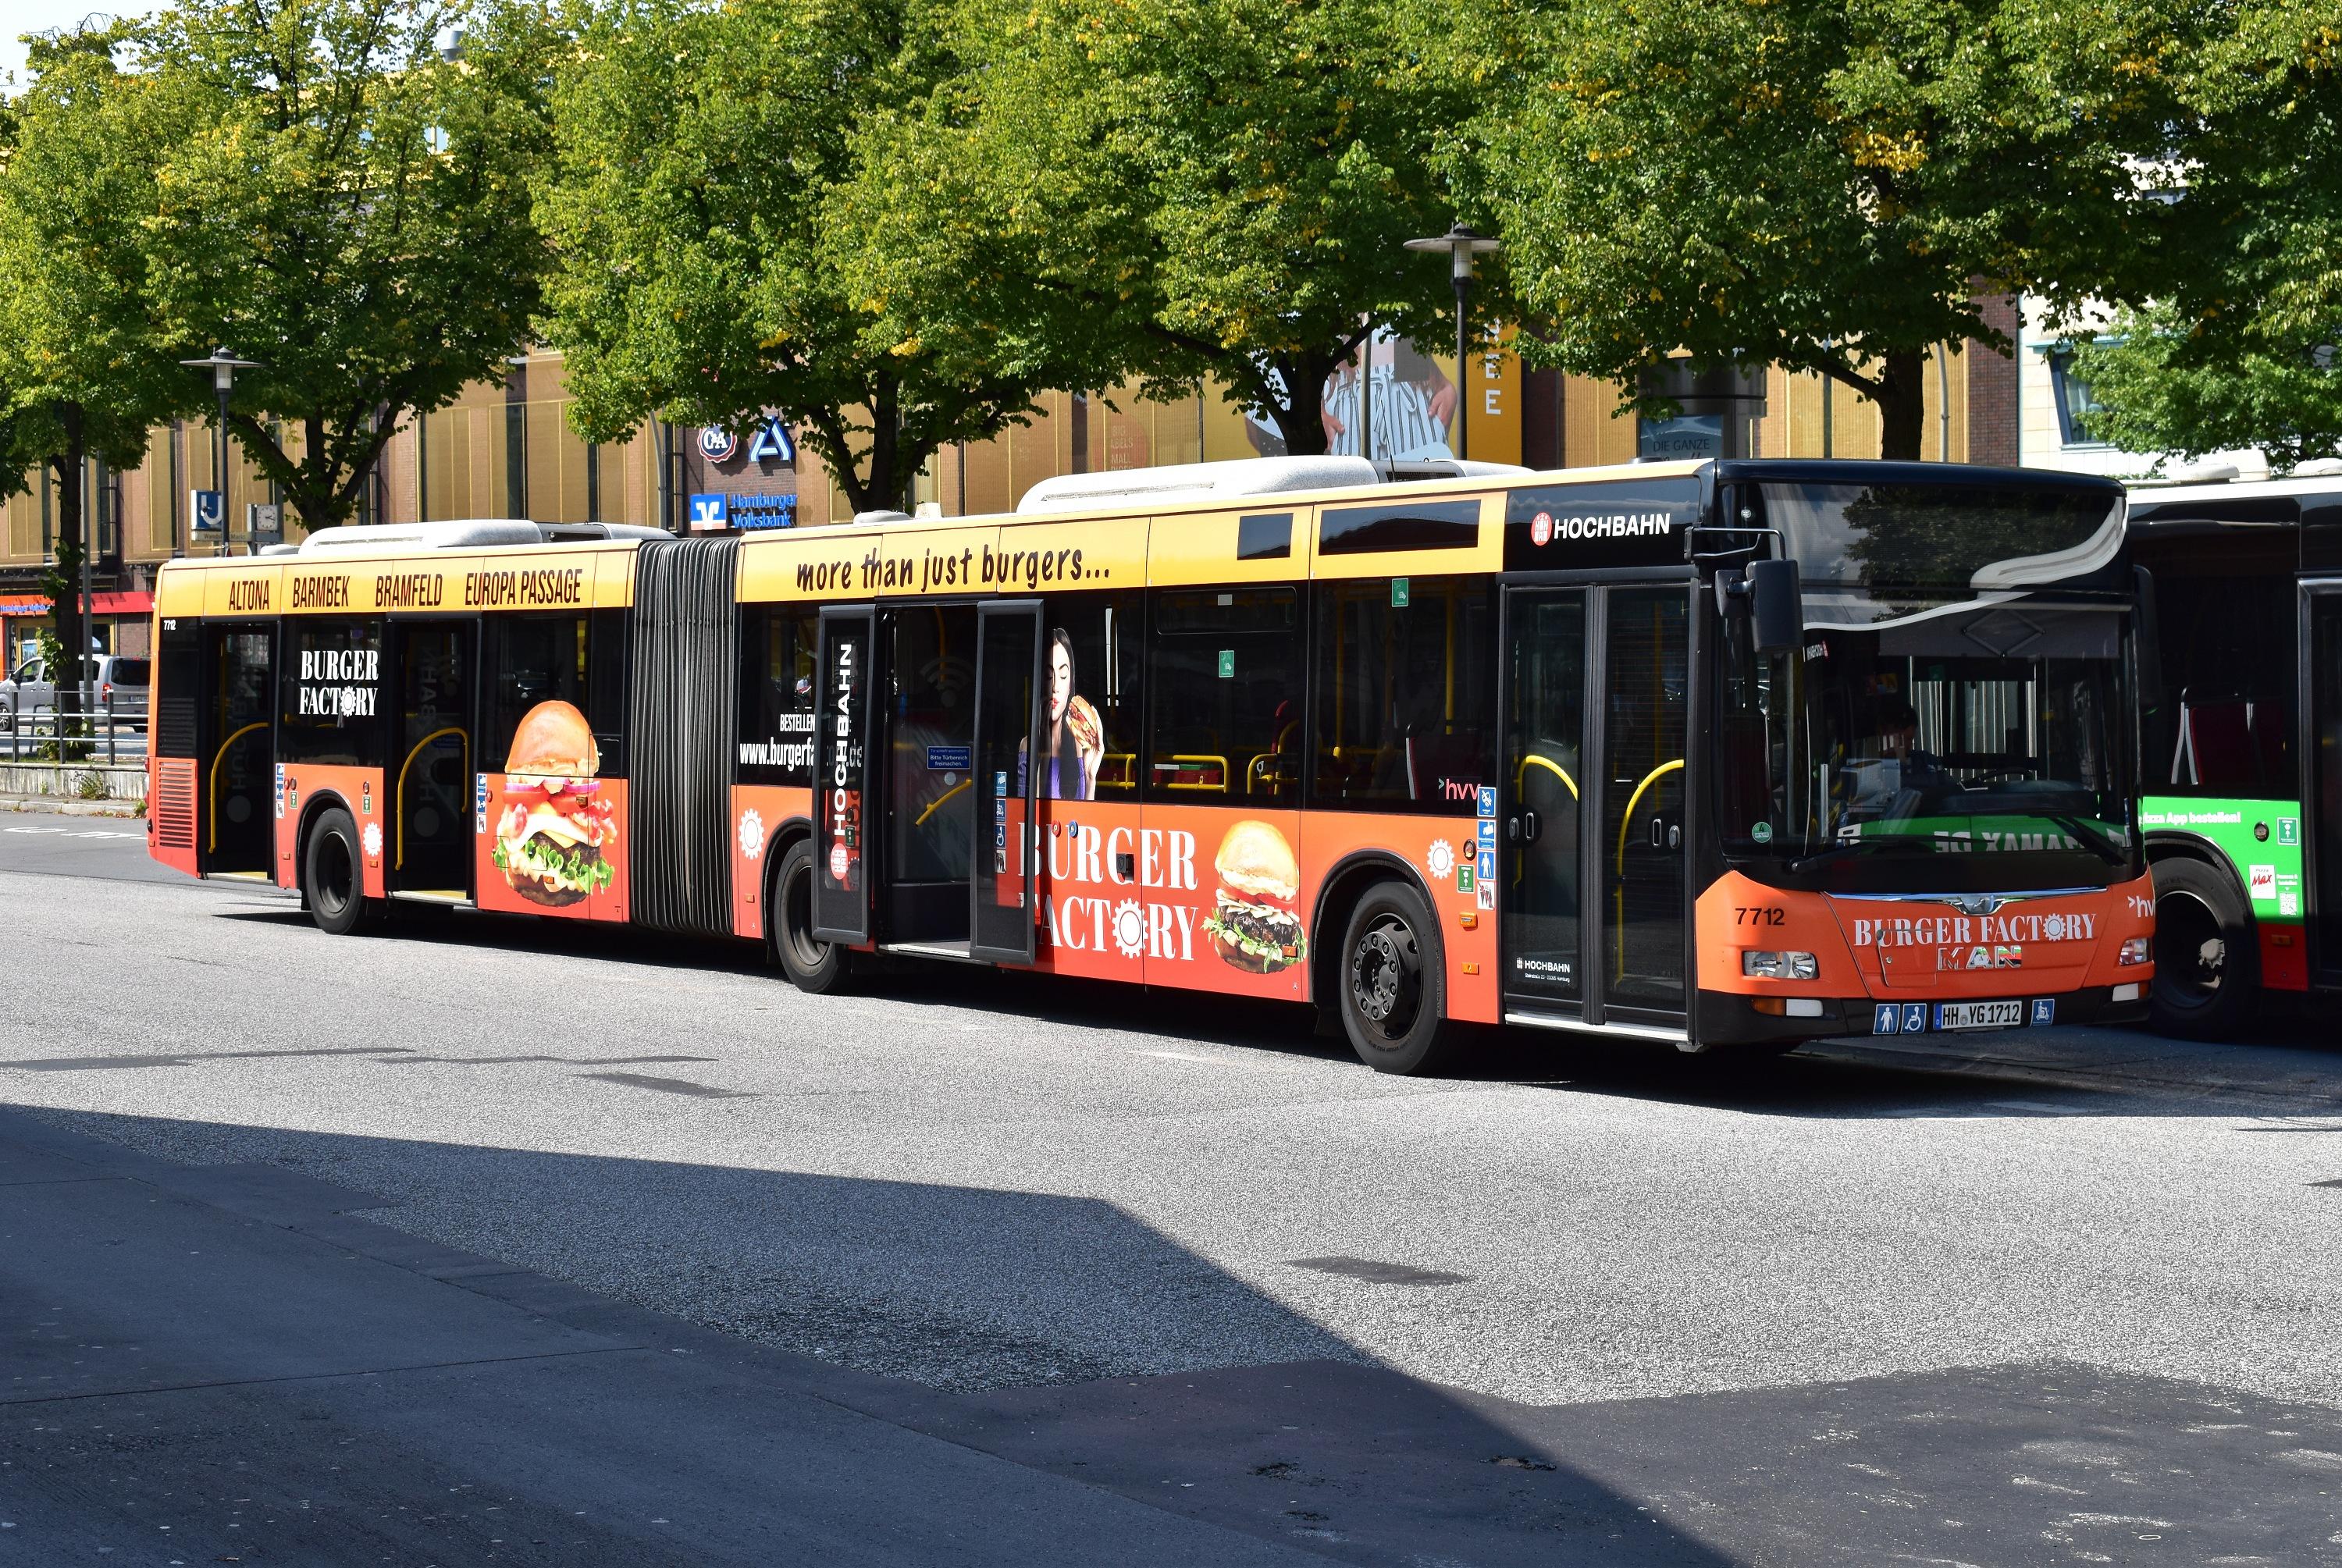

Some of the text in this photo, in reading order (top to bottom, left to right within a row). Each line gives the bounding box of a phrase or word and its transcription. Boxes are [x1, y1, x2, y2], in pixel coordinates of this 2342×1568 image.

[1653, 438, 1710, 452] DIE GANZE
[731, 491, 798, 510] Hamburger
[731, 511, 792, 528] Volksbank
[1554, 513, 1671, 539] HOCHBAHN
[796, 544, 1110, 593] more than just burgers...
[229, 568, 583, 611] ALTONA BARMBEK BRAMFELD EUROPA PASSAGE
[300, 650, 379, 681] BURGER
[298, 685, 379, 717] FACTORY
[780, 713, 816, 732] BESTELLEN
[835, 644, 852, 836] HOCHBAHN
[2166, 812, 2188, 826] App
[1018, 822, 1199, 891] BURGER
[1019, 893, 1199, 962] ACTORY
[1735, 908, 1785, 926] 7712
[1853, 912, 2097, 947] BURGER FACTORY
[1524, 959, 1571, 973] HOCHBAHN
[1937, 944, 2023, 971] MAN
[1942, 1007, 1959, 1026] HH
[1969, 1004, 1985, 1023] YG
[1988, 1003, 2020, 1024] 1712
